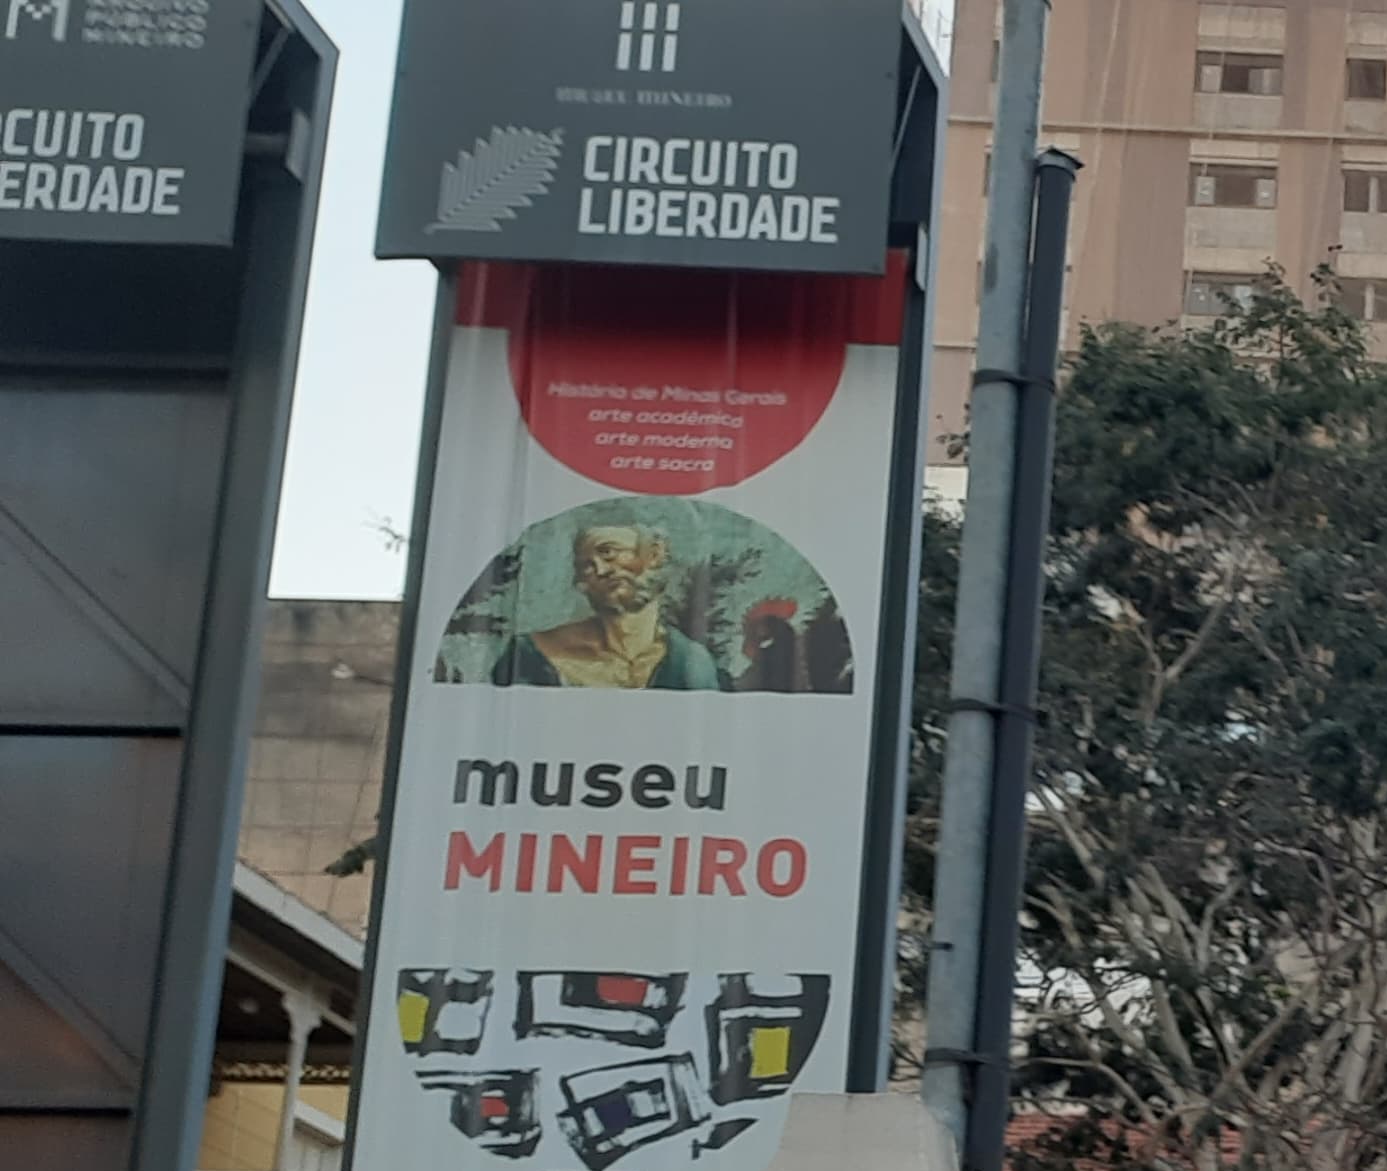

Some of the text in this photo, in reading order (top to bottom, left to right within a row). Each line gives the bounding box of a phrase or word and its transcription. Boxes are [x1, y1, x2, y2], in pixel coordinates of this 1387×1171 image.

[583, 135, 799, 189] CIRCUITO
[577, 186, 842, 244] LIBERDADE
[547, 381, 788, 406] História de Minas Gerais
[588, 407, 744, 429] arte acadêmica
[595, 431, 734, 450] arte moderna
[610, 455, 715, 473] arte sacra
[453, 757, 727, 811] museu
[443, 830, 808, 898] MINEIRO
